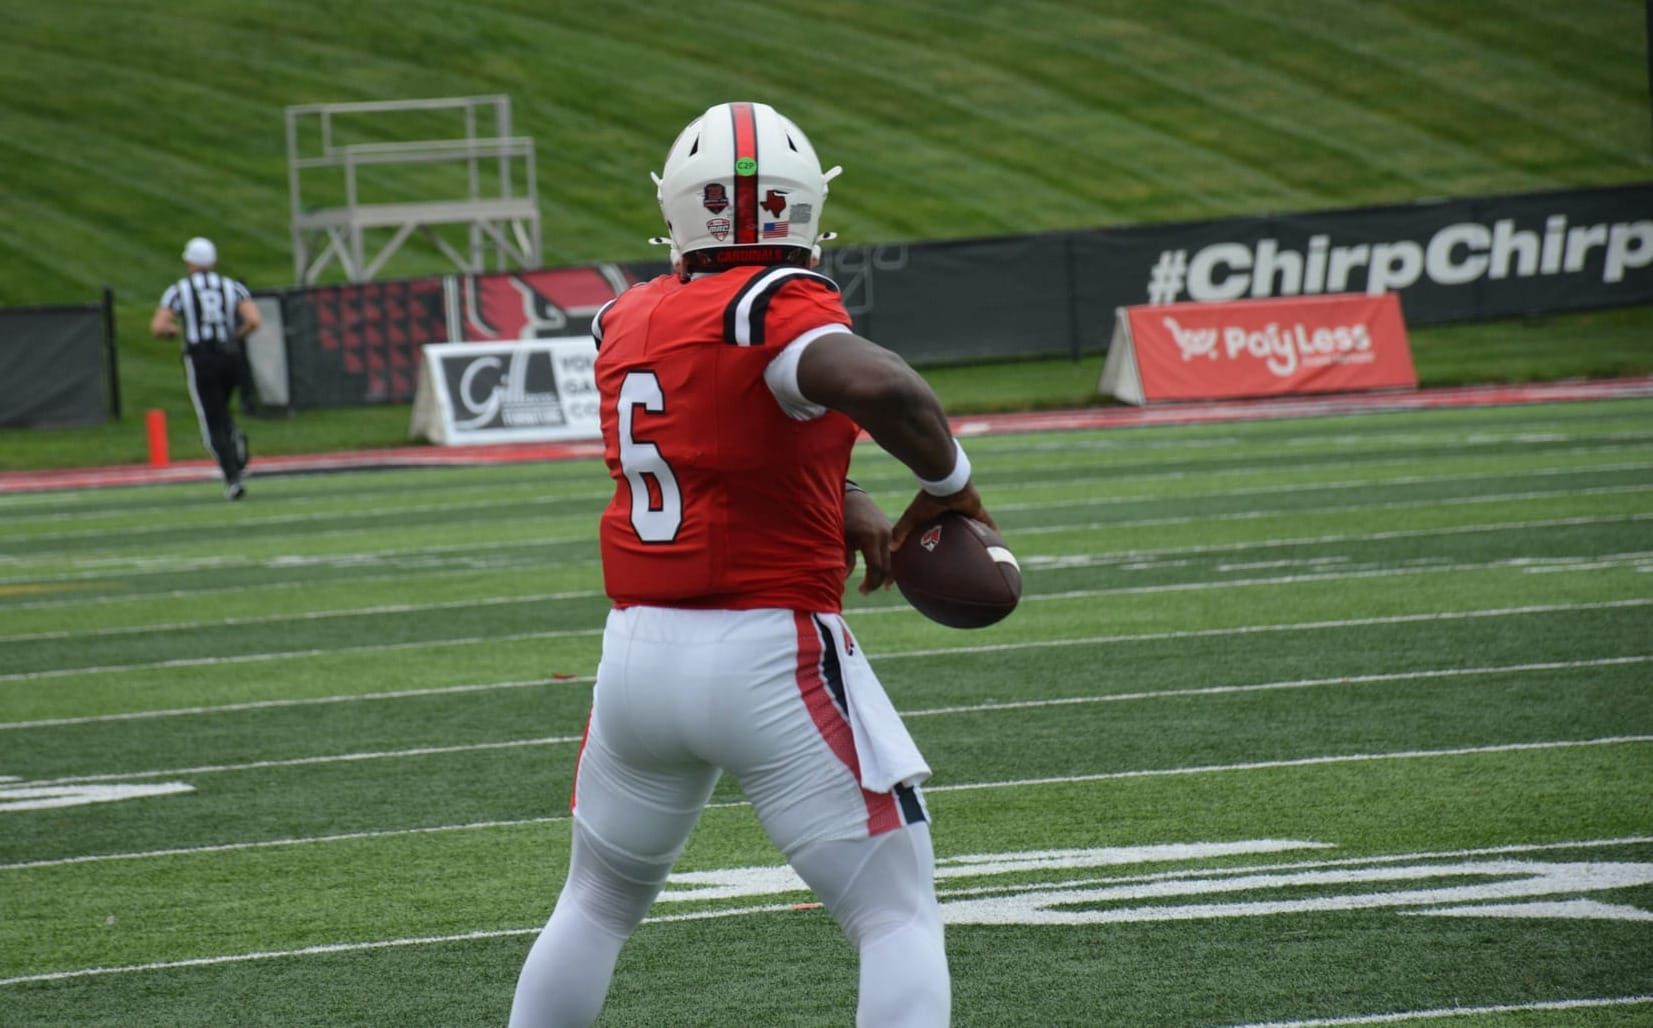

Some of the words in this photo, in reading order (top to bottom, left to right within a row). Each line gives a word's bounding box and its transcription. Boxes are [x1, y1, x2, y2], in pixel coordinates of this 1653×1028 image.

[1147, 215, 1653, 305] #ChirpChirp
[1224, 322, 1371, 377] PayLess
[617, 369, 684, 544] 6
